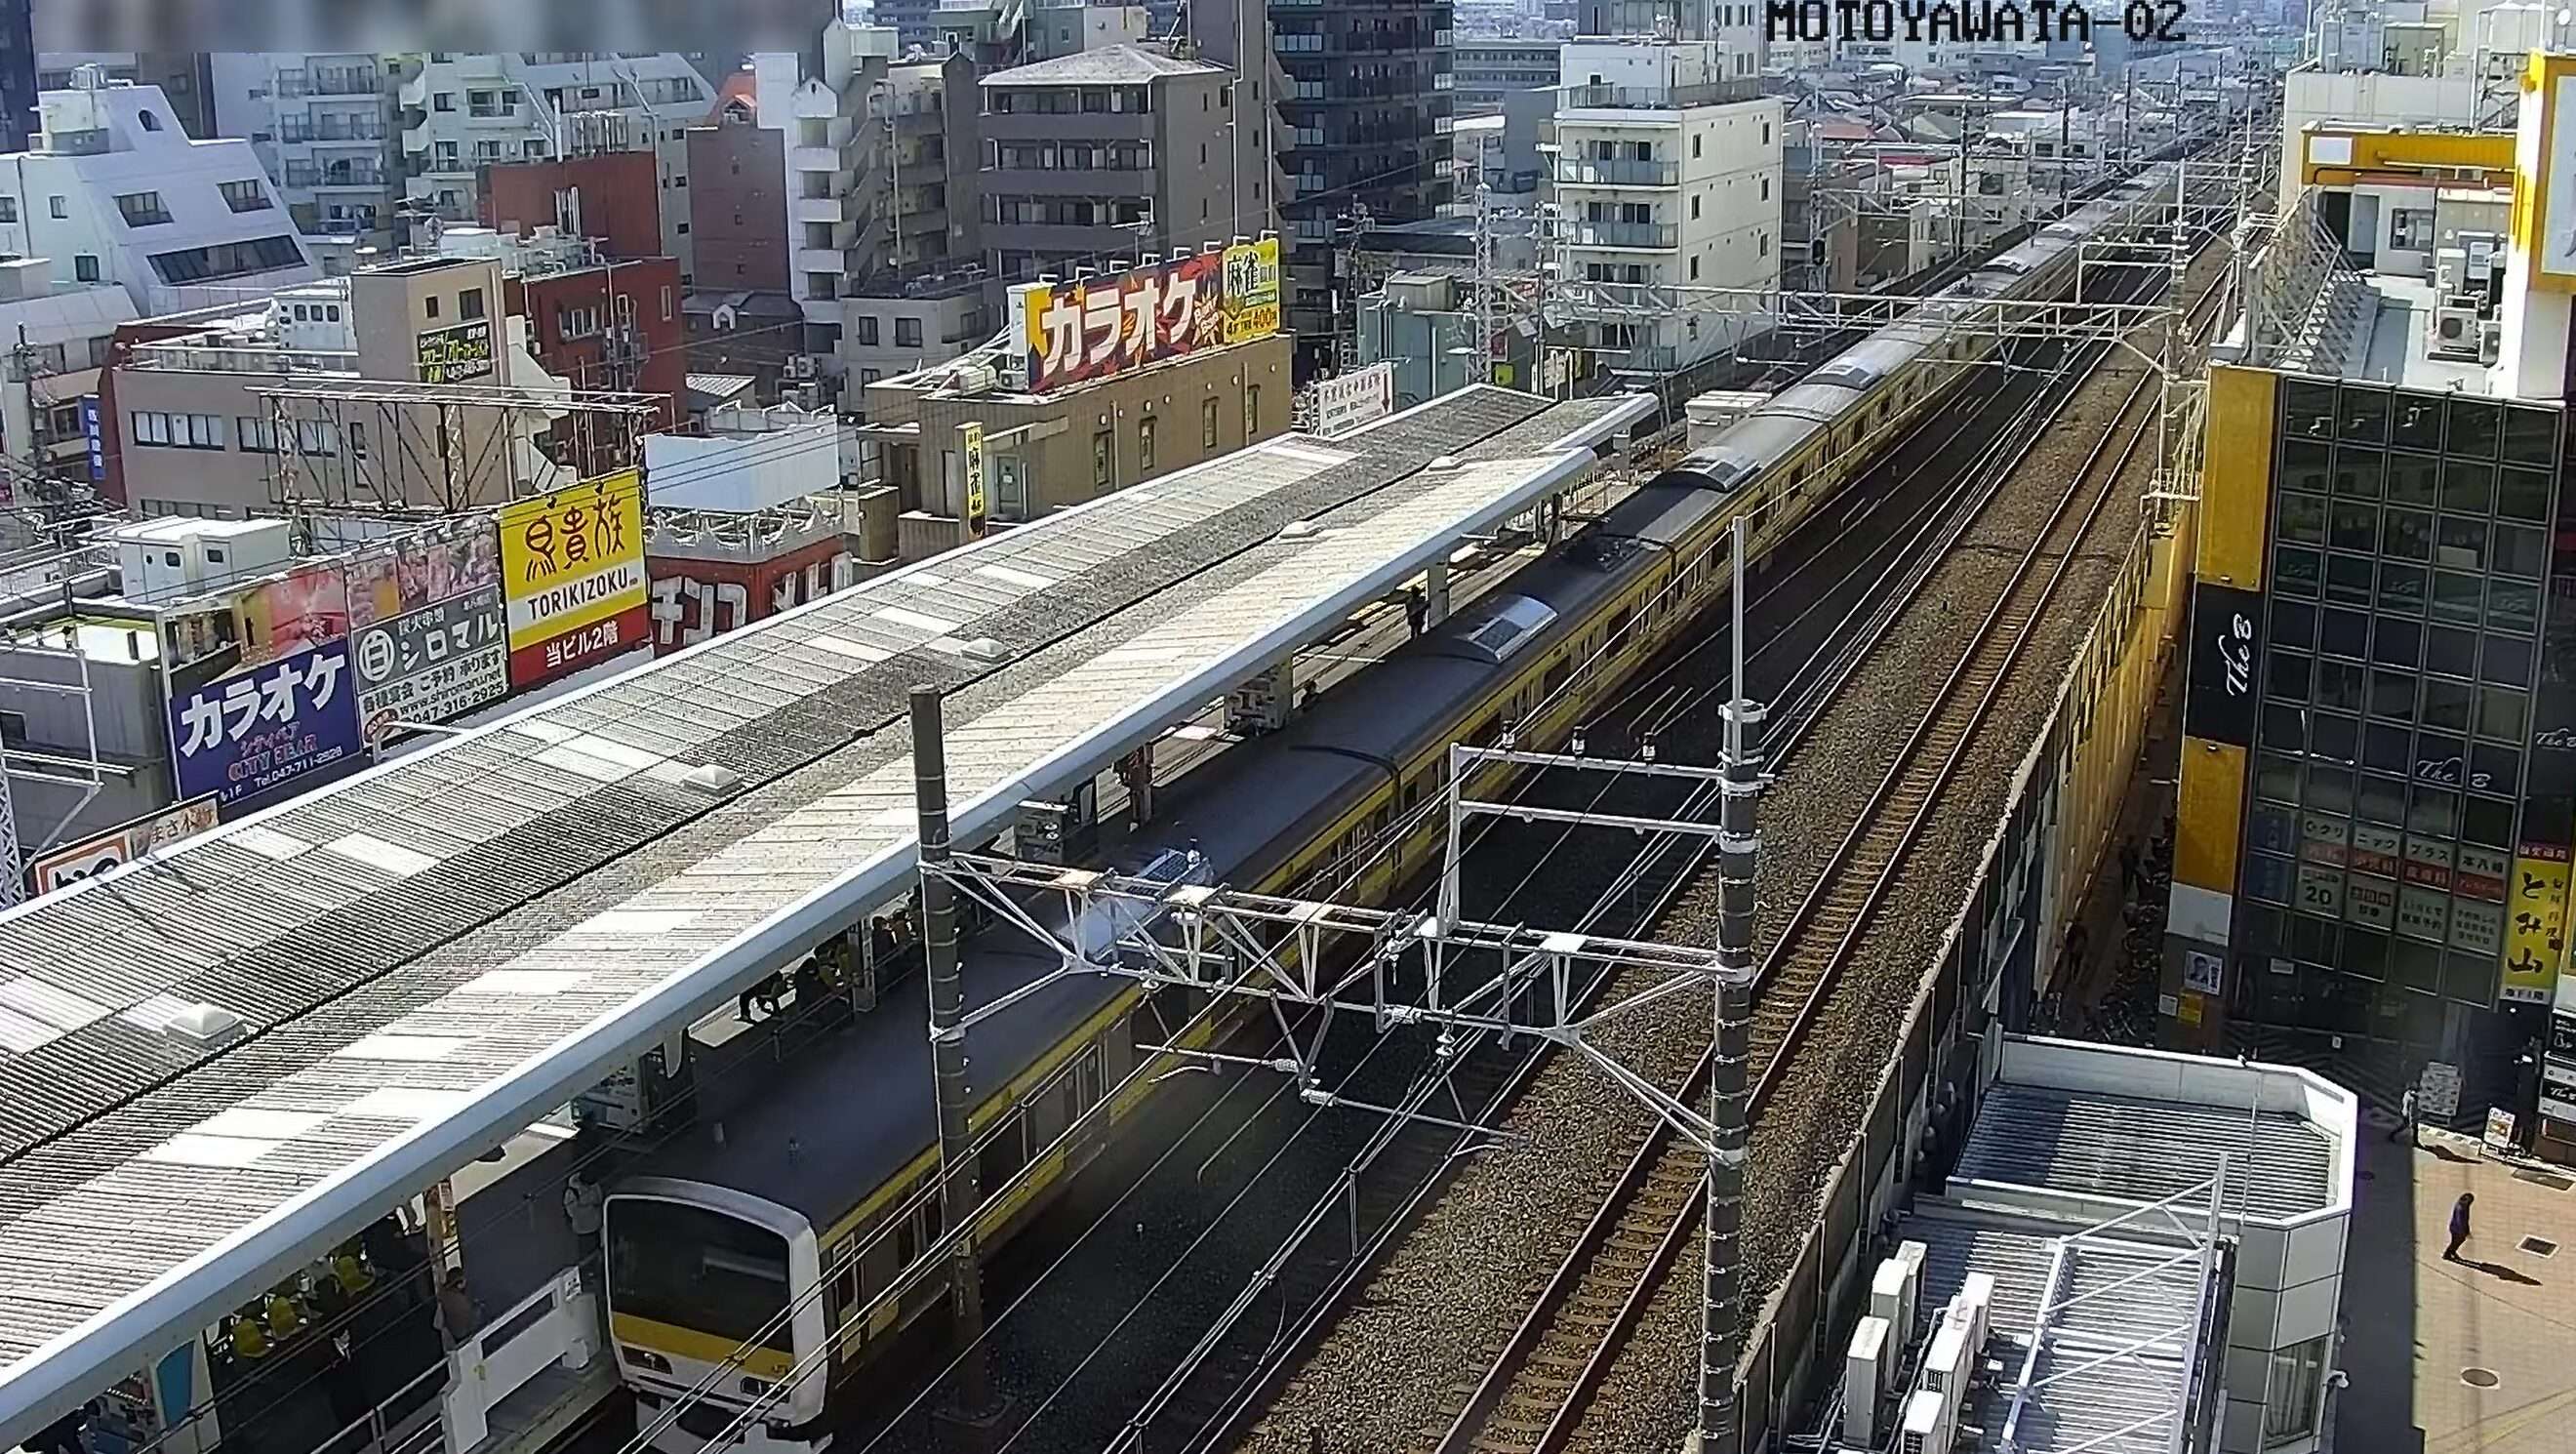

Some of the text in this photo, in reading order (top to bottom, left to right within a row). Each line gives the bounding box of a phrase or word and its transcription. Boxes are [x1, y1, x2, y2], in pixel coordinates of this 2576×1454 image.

[1042, 273, 1195, 378] カラオケ
[528, 567, 628, 620] TORIKIZOKU
[400, 613, 499, 671] シロマル
[545, 621, 620, 667] 当ビル2階
[180, 654, 345, 758] カラオケ
[2417, 756, 2491, 788] The B
[2305, 885, 2332, 906] 20
[2508, 871, 2545, 973] とみ山
